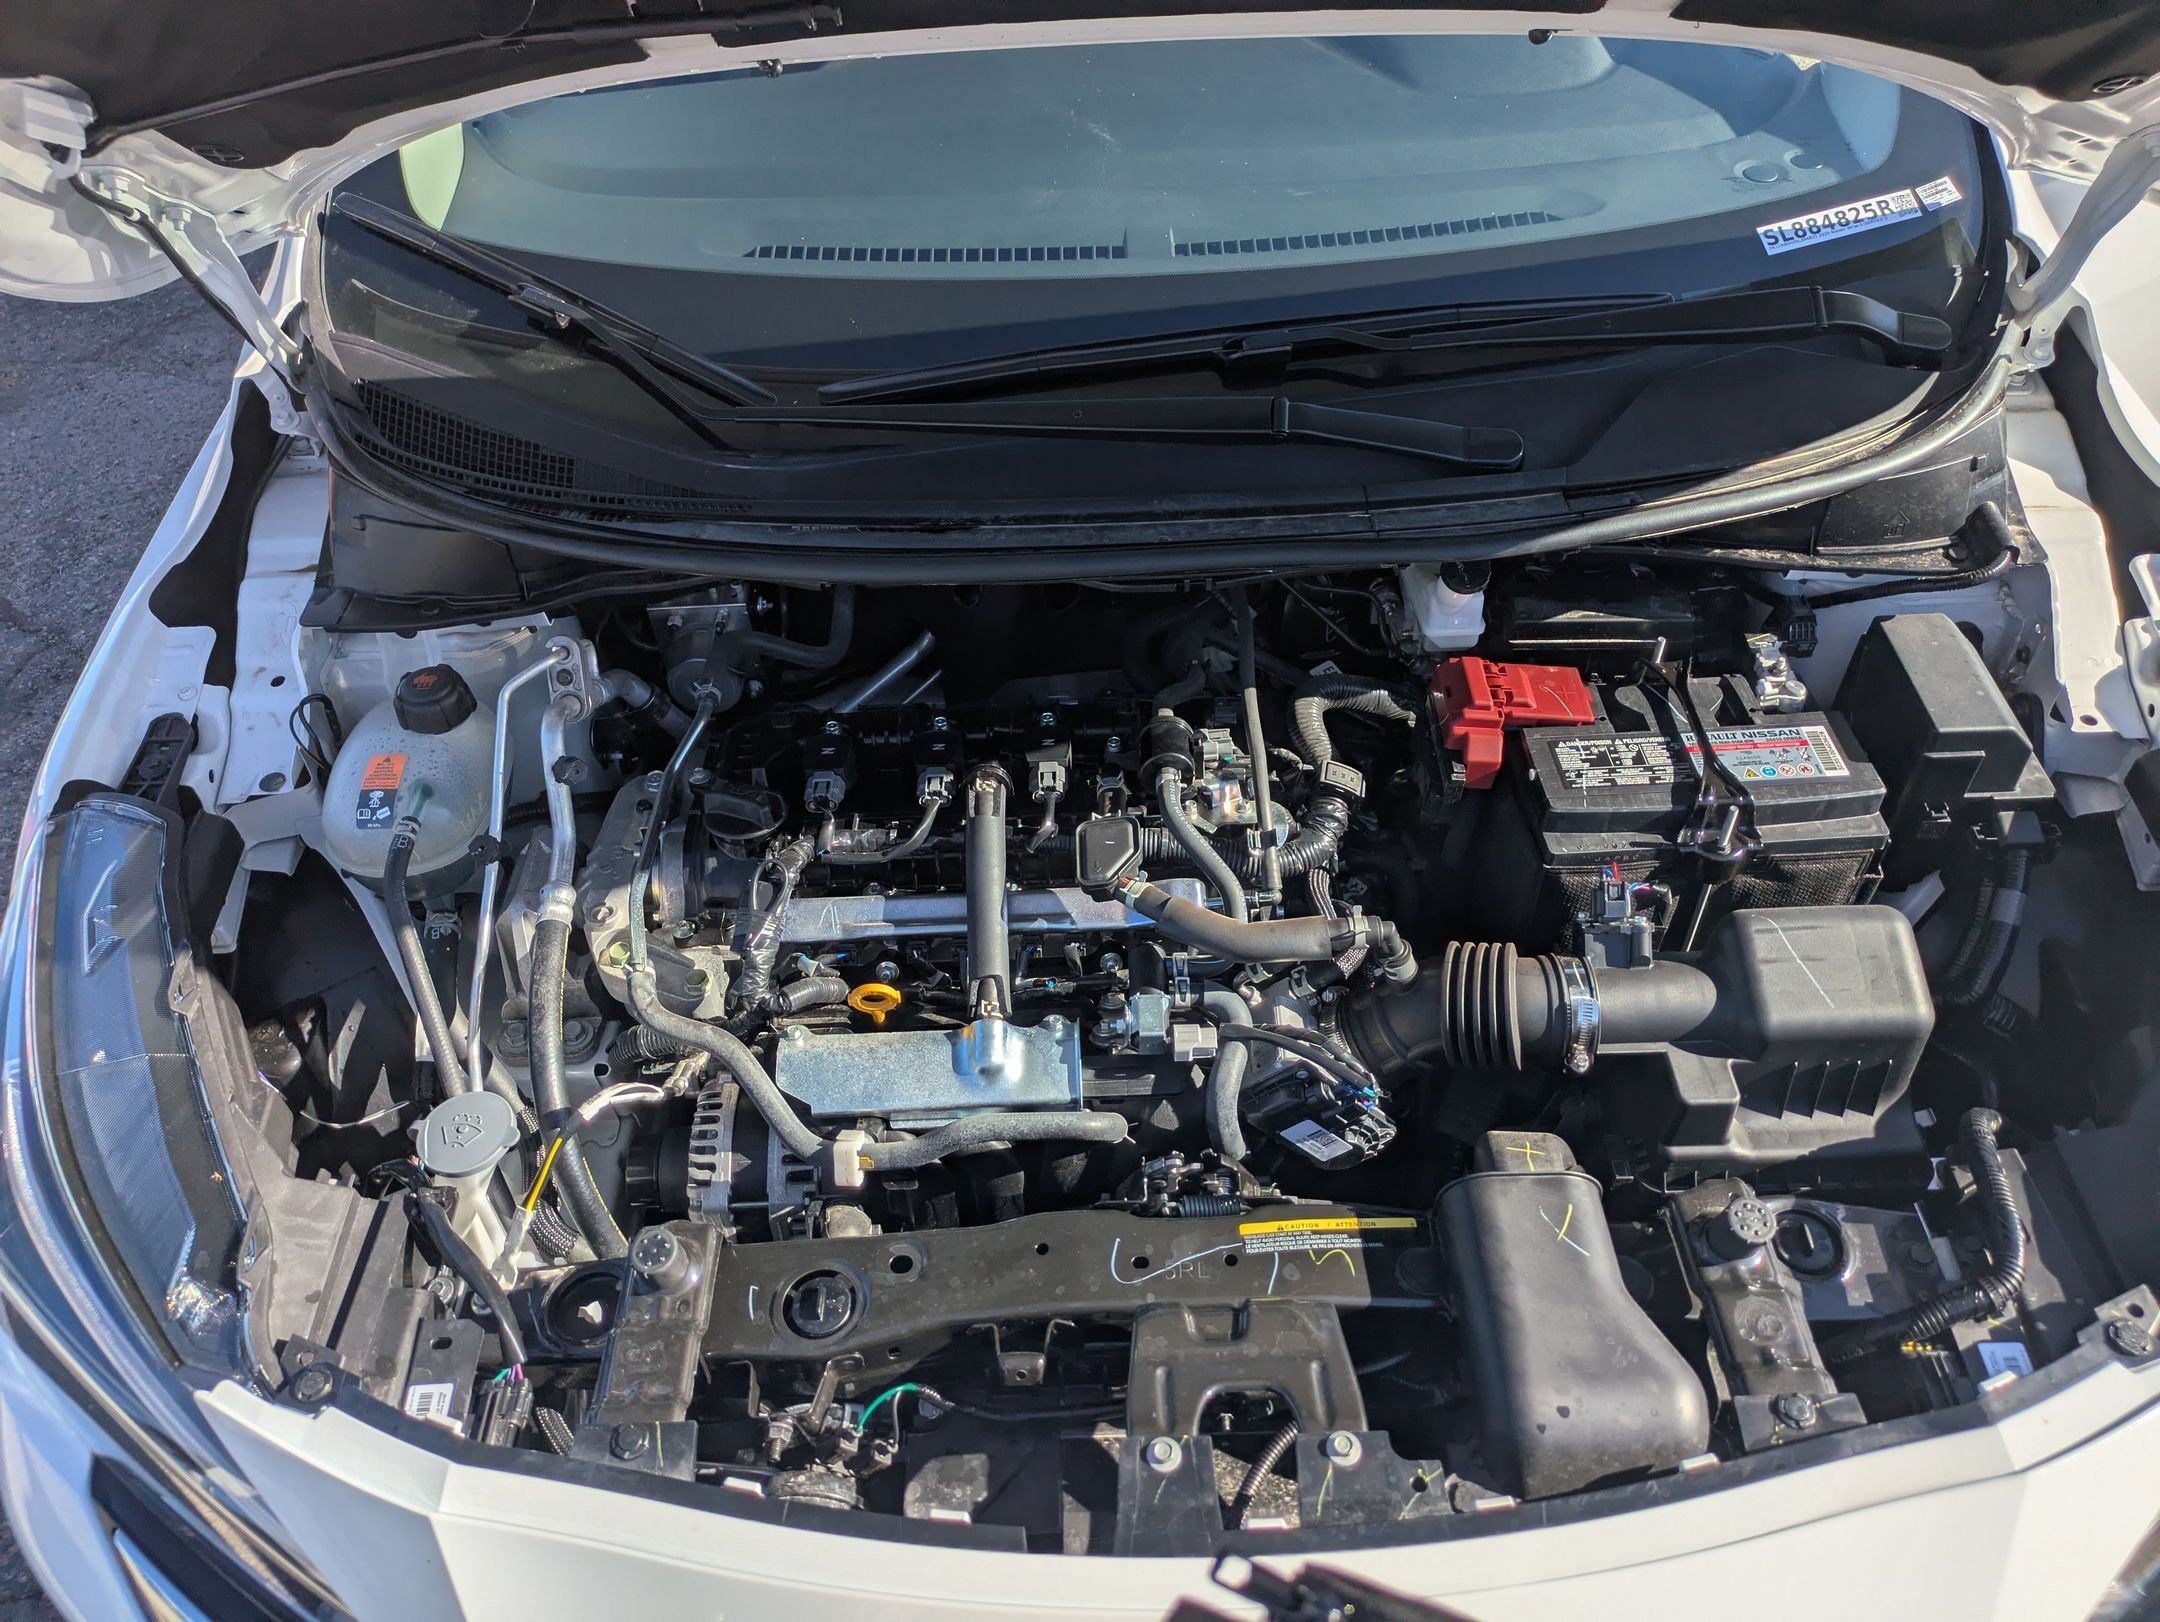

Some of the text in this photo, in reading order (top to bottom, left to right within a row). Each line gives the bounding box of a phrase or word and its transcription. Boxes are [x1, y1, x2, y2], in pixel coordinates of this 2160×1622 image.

[1762, 198, 1896, 247] SL884825R
[1686, 730, 1741, 743] RAULT
[1741, 727, 1802, 740] NISSAN
[1284, 1222, 1320, 1231] CAUTION
[1335, 1221, 1377, 1229] ATTENTION
